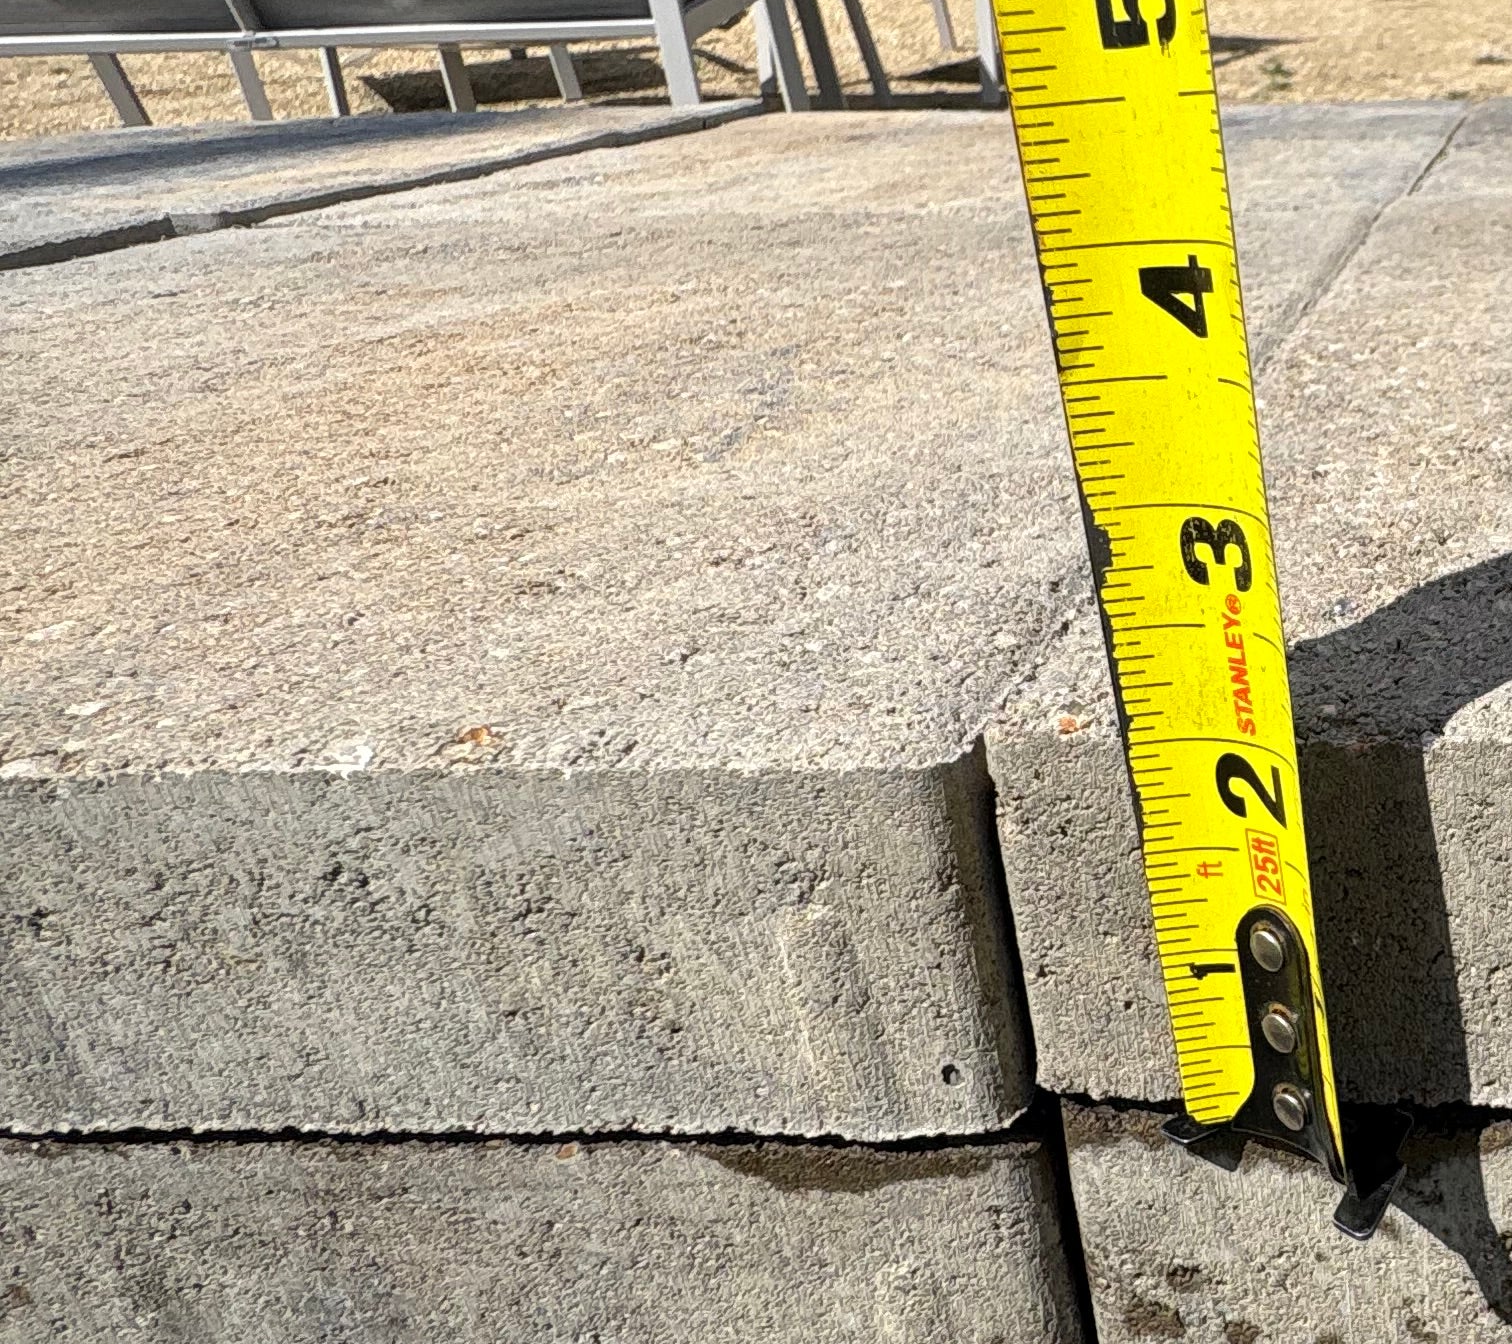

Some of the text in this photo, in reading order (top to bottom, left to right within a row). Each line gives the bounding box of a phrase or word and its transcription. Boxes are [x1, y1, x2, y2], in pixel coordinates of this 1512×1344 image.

[1138, 254, 1214, 338] 4
[1180, 516, 1252, 593] 3
[1215, 752, 1288, 830] 2
[1251, 836, 1283, 897] 25ft
[1189, 962, 1236, 981] 1
